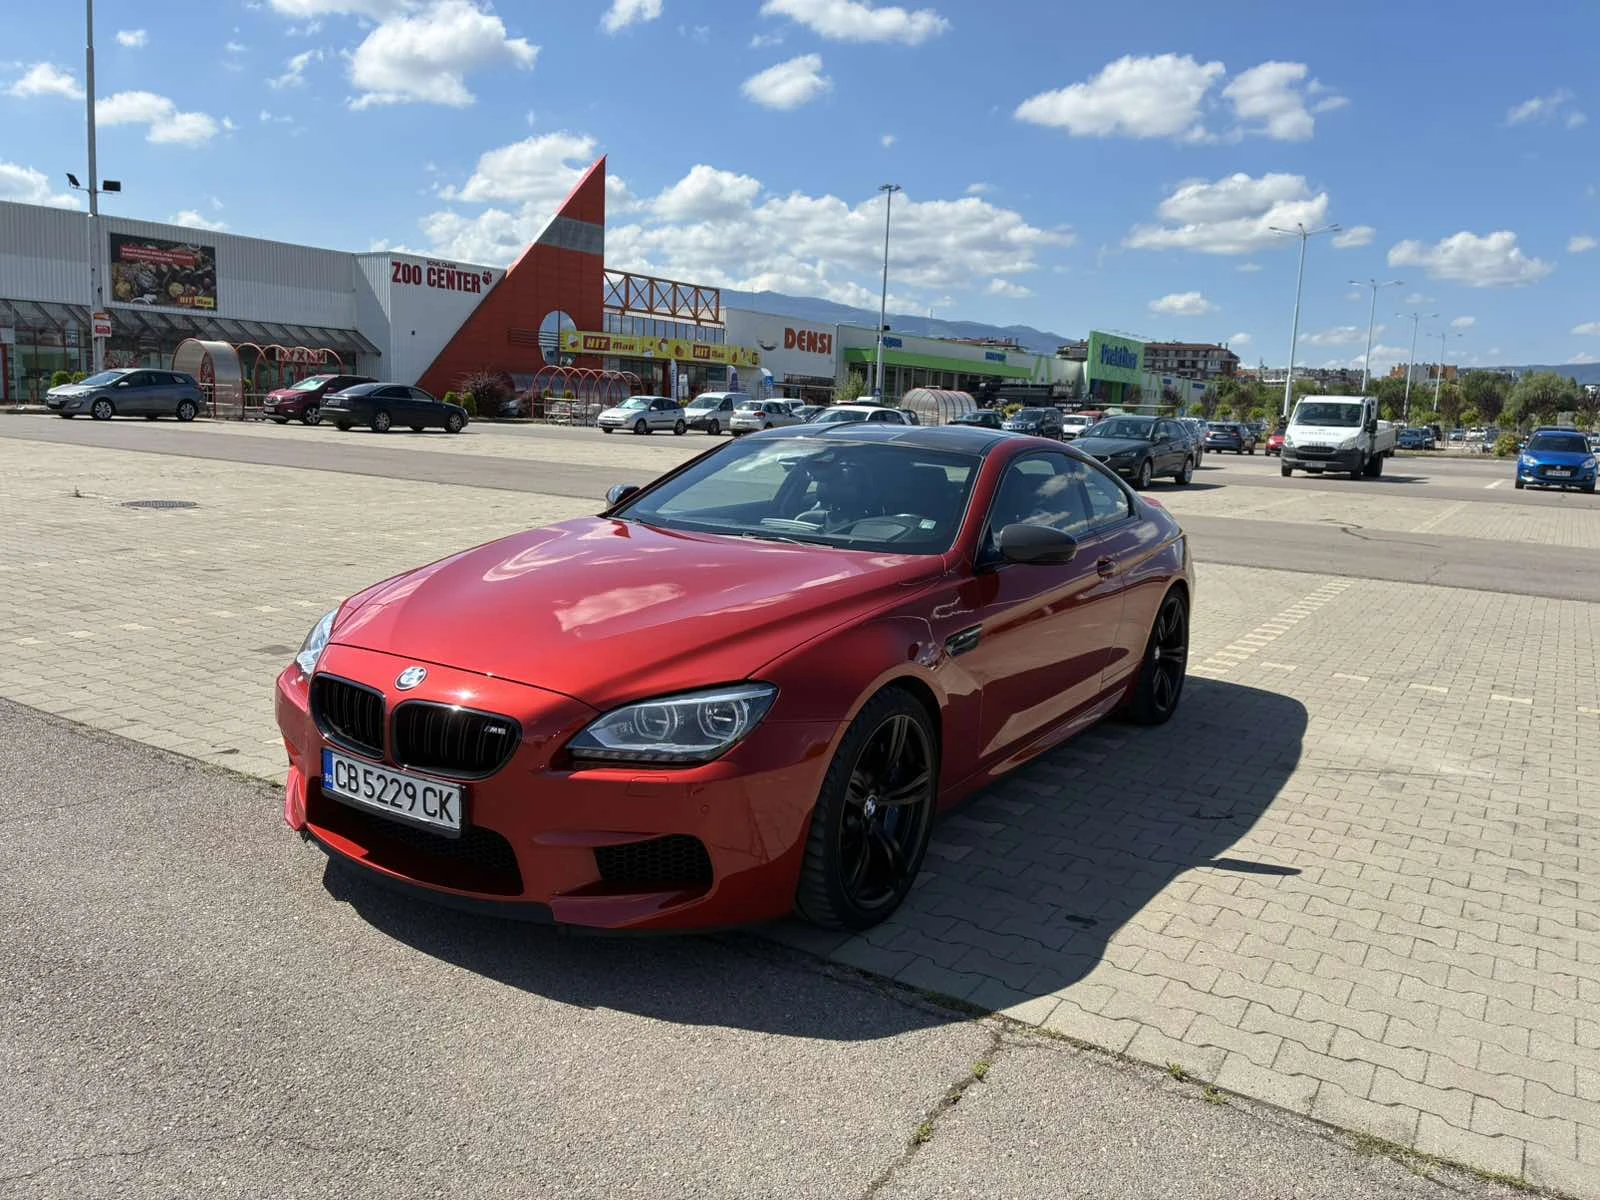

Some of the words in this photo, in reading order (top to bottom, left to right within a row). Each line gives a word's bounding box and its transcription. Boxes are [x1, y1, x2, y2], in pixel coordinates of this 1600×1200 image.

[392, 261, 421, 285] ZOO
[427, 267, 480, 293] CENTER
[586, 338, 608, 349] HIT
[695, 346, 710, 358] HIT
[784, 327, 833, 355] DENSI
[335, 760, 360, 793] CB
[363, 768, 417, 811] 5229
[422, 786, 454, 822] CK
